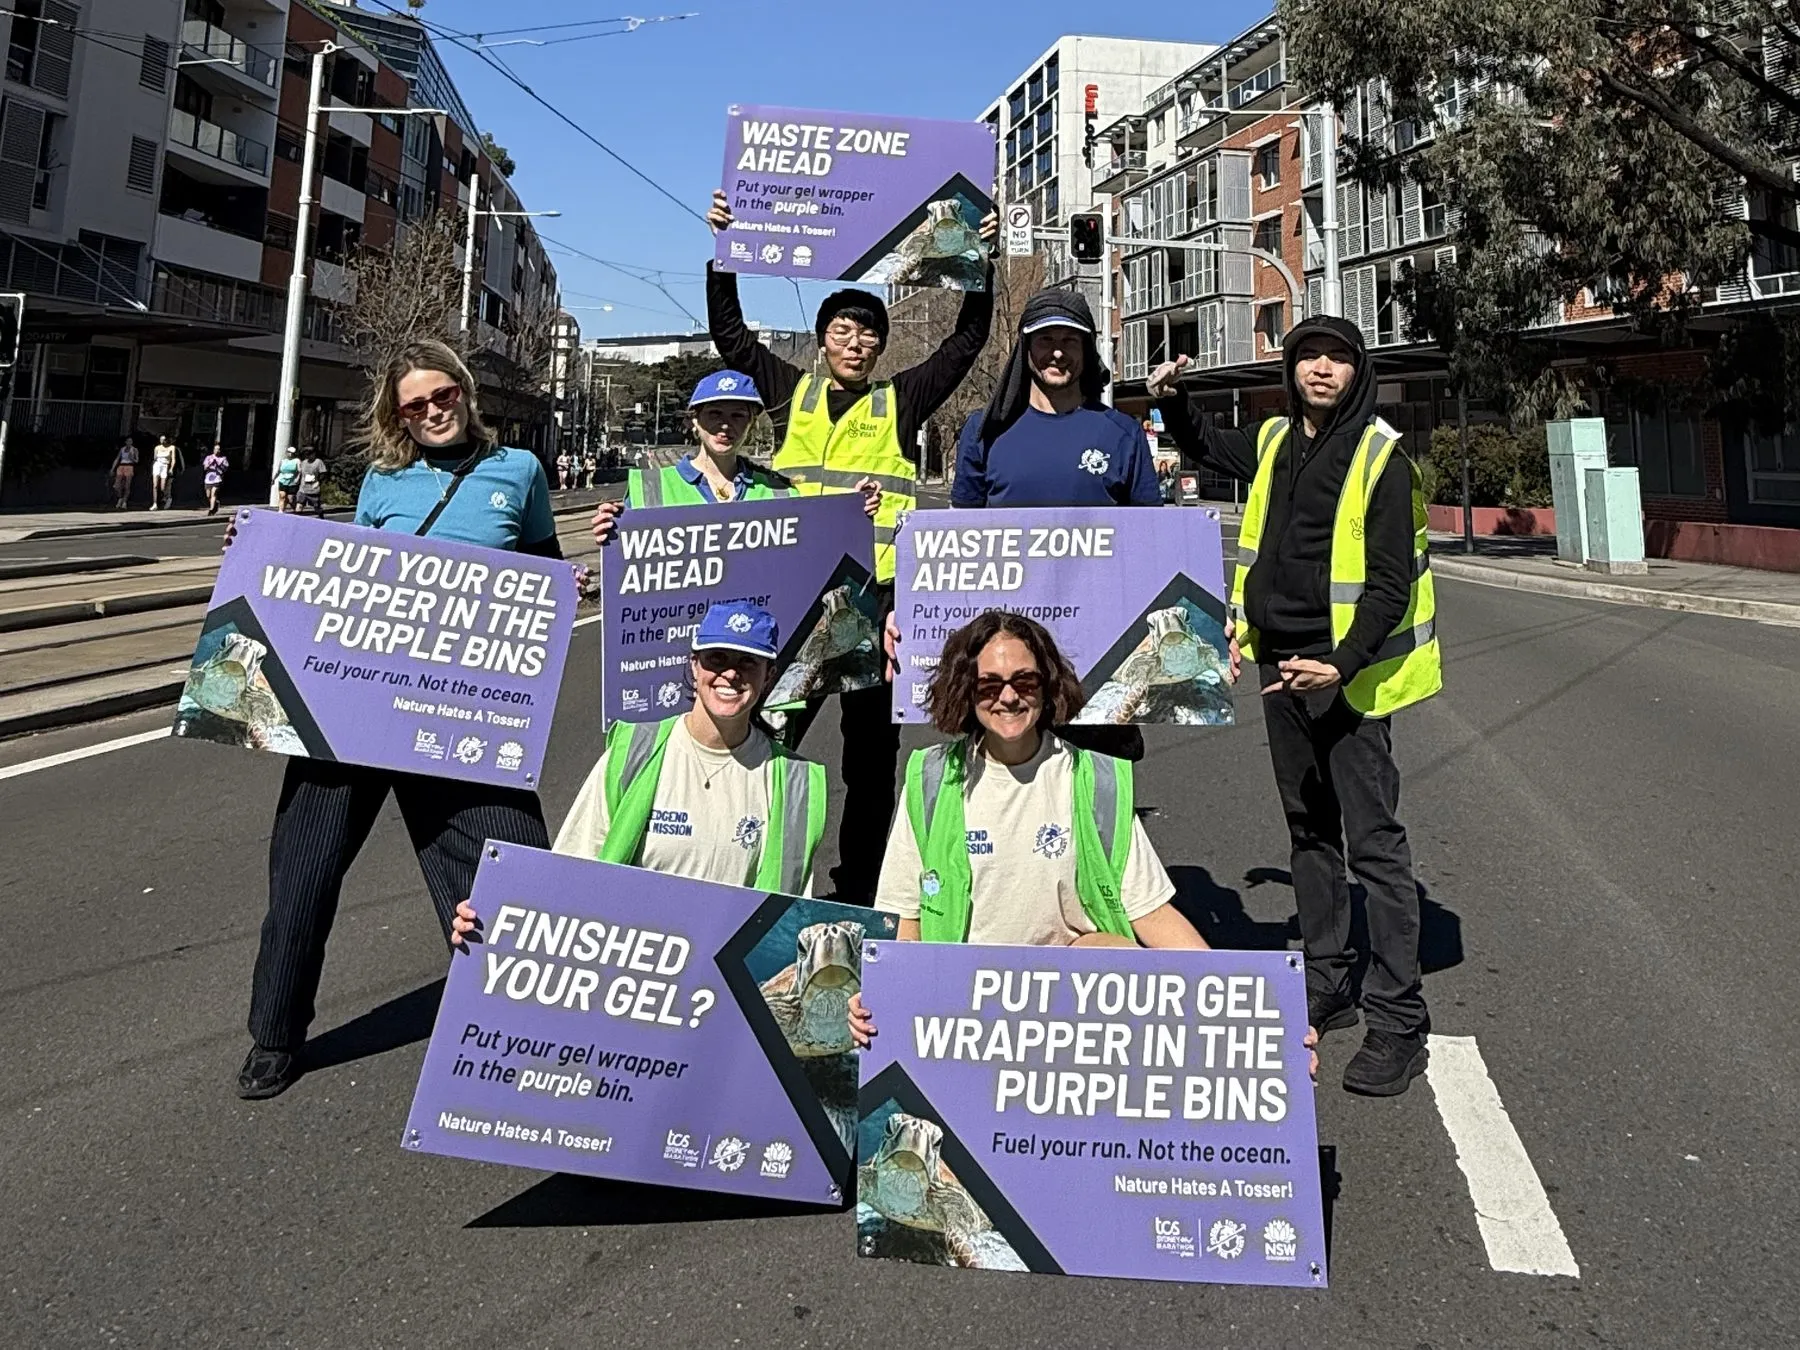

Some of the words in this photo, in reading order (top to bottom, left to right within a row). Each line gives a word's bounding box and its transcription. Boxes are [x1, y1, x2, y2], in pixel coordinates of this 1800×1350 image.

[742, 121, 834, 150] WASTE
[836, 128, 910, 156] ZONE
[737, 147, 832, 176] AHEAD
[735, 196, 747, 208] in
[751, 198, 772, 210] the
[774, 201, 819, 216] purple
[821, 203, 845, 216] bin.
[736, 180, 759, 193] Put
[762, 183, 792, 197] your
[795, 185, 815, 199] gel
[819, 188, 875, 203] wrapper
[732, 220, 763, 231] Nature
[765, 222, 791, 233] Hates
[793, 225, 800, 233] A
[802, 225, 836, 236] Tosser!
[1012, 231, 1027, 239] NO
[620, 523, 722, 560] WASTE
[727, 517, 799, 549] ZONE
[914, 528, 1022, 559] WASTE
[1028, 528, 1114, 557] ZONE
[315, 538, 392, 577] PUT
[398, 551, 489, 595] YOUR
[493, 569, 556, 607] GEL
[620, 557, 723, 594] AHEAD
[911, 562, 1023, 591] AHEAD
[262, 565, 437, 623] WRAPPER
[439, 595, 481, 630] IN
[487, 602, 556, 642] THE
[621, 606, 648, 624] Put
[651, 604, 684, 623] your
[688, 598, 709, 619] gel
[912, 604, 939, 619] Put
[943, 605, 979, 622] your
[1011, 605, 1080, 621] wrapper
[314, 612, 460, 663] PURPLE
[460, 635, 546, 677] BINS
[622, 630, 635, 645] in
[639, 626, 664, 643] the
[667, 623, 700, 643] purp
[912, 624, 925, 640] in
[621, 660, 656, 672] Nature
[658, 655, 688, 667] Hates
[910, 655, 942, 667] Natur
[303, 655, 339, 675] Fuel
[340, 664, 380, 682] your
[381, 671, 413, 687] run.
[417, 673, 448, 692] Not
[450, 680, 478, 697] the
[481, 687, 535, 706] ocean.
[392, 696, 436, 714] Nature
[436, 703, 473, 721] Hates
[473, 709, 484, 722] A
[486, 711, 531, 729] Tosser!
[496, 756, 522, 767] NSW
[653, 823, 692, 836] MISSION
[488, 905, 690, 976] FINISHED
[483, 952, 599, 1012] YOUR
[604, 975, 715, 1029] GEL?
[971, 970, 1060, 1013] PUT
[1070, 972, 1186, 1017] YOUR
[1196, 975, 1281, 1019] GEL
[460, 1023, 501, 1050] Put
[502, 1035, 556, 1058] your
[558, 1044, 595, 1067] gel
[598, 1050, 689, 1079] wrapper
[913, 1016, 1133, 1066] WRAPPER
[1142, 1025, 1187, 1068] IN
[1197, 1025, 1286, 1070] THE
[452, 1054, 474, 1078] in
[479, 1059, 517, 1084] the
[517, 1069, 592, 1097] purple
[595, 1077, 634, 1102] bin.
[995, 1070, 1173, 1119] PURPLE
[1182, 1077, 1288, 1122] BINS
[438, 1112, 492, 1135] Nature
[494, 1121, 539, 1142] Hates
[540, 1128, 553, 1145] A
[557, 1129, 612, 1153] Tosser!
[666, 1129, 691, 1148] tcs
[991, 1132, 1036, 1155] Fuel
[1040, 1139, 1087, 1161] your
[1091, 1140, 1132, 1159] run.
[1138, 1138, 1175, 1161] Not
[1181, 1140, 1215, 1162] the
[1220, 1146, 1291, 1165] ocean.
[761, 1160, 790, 1174] NSW
[1114, 1175, 1168, 1195] Nature
[1171, 1178, 1217, 1196] Hates
[1220, 1180, 1232, 1197] A
[1234, 1180, 1293, 1198] Tosser!
[1155, 1216, 1180, 1236] tcs
[1264, 1242, 1297, 1256] NSW
